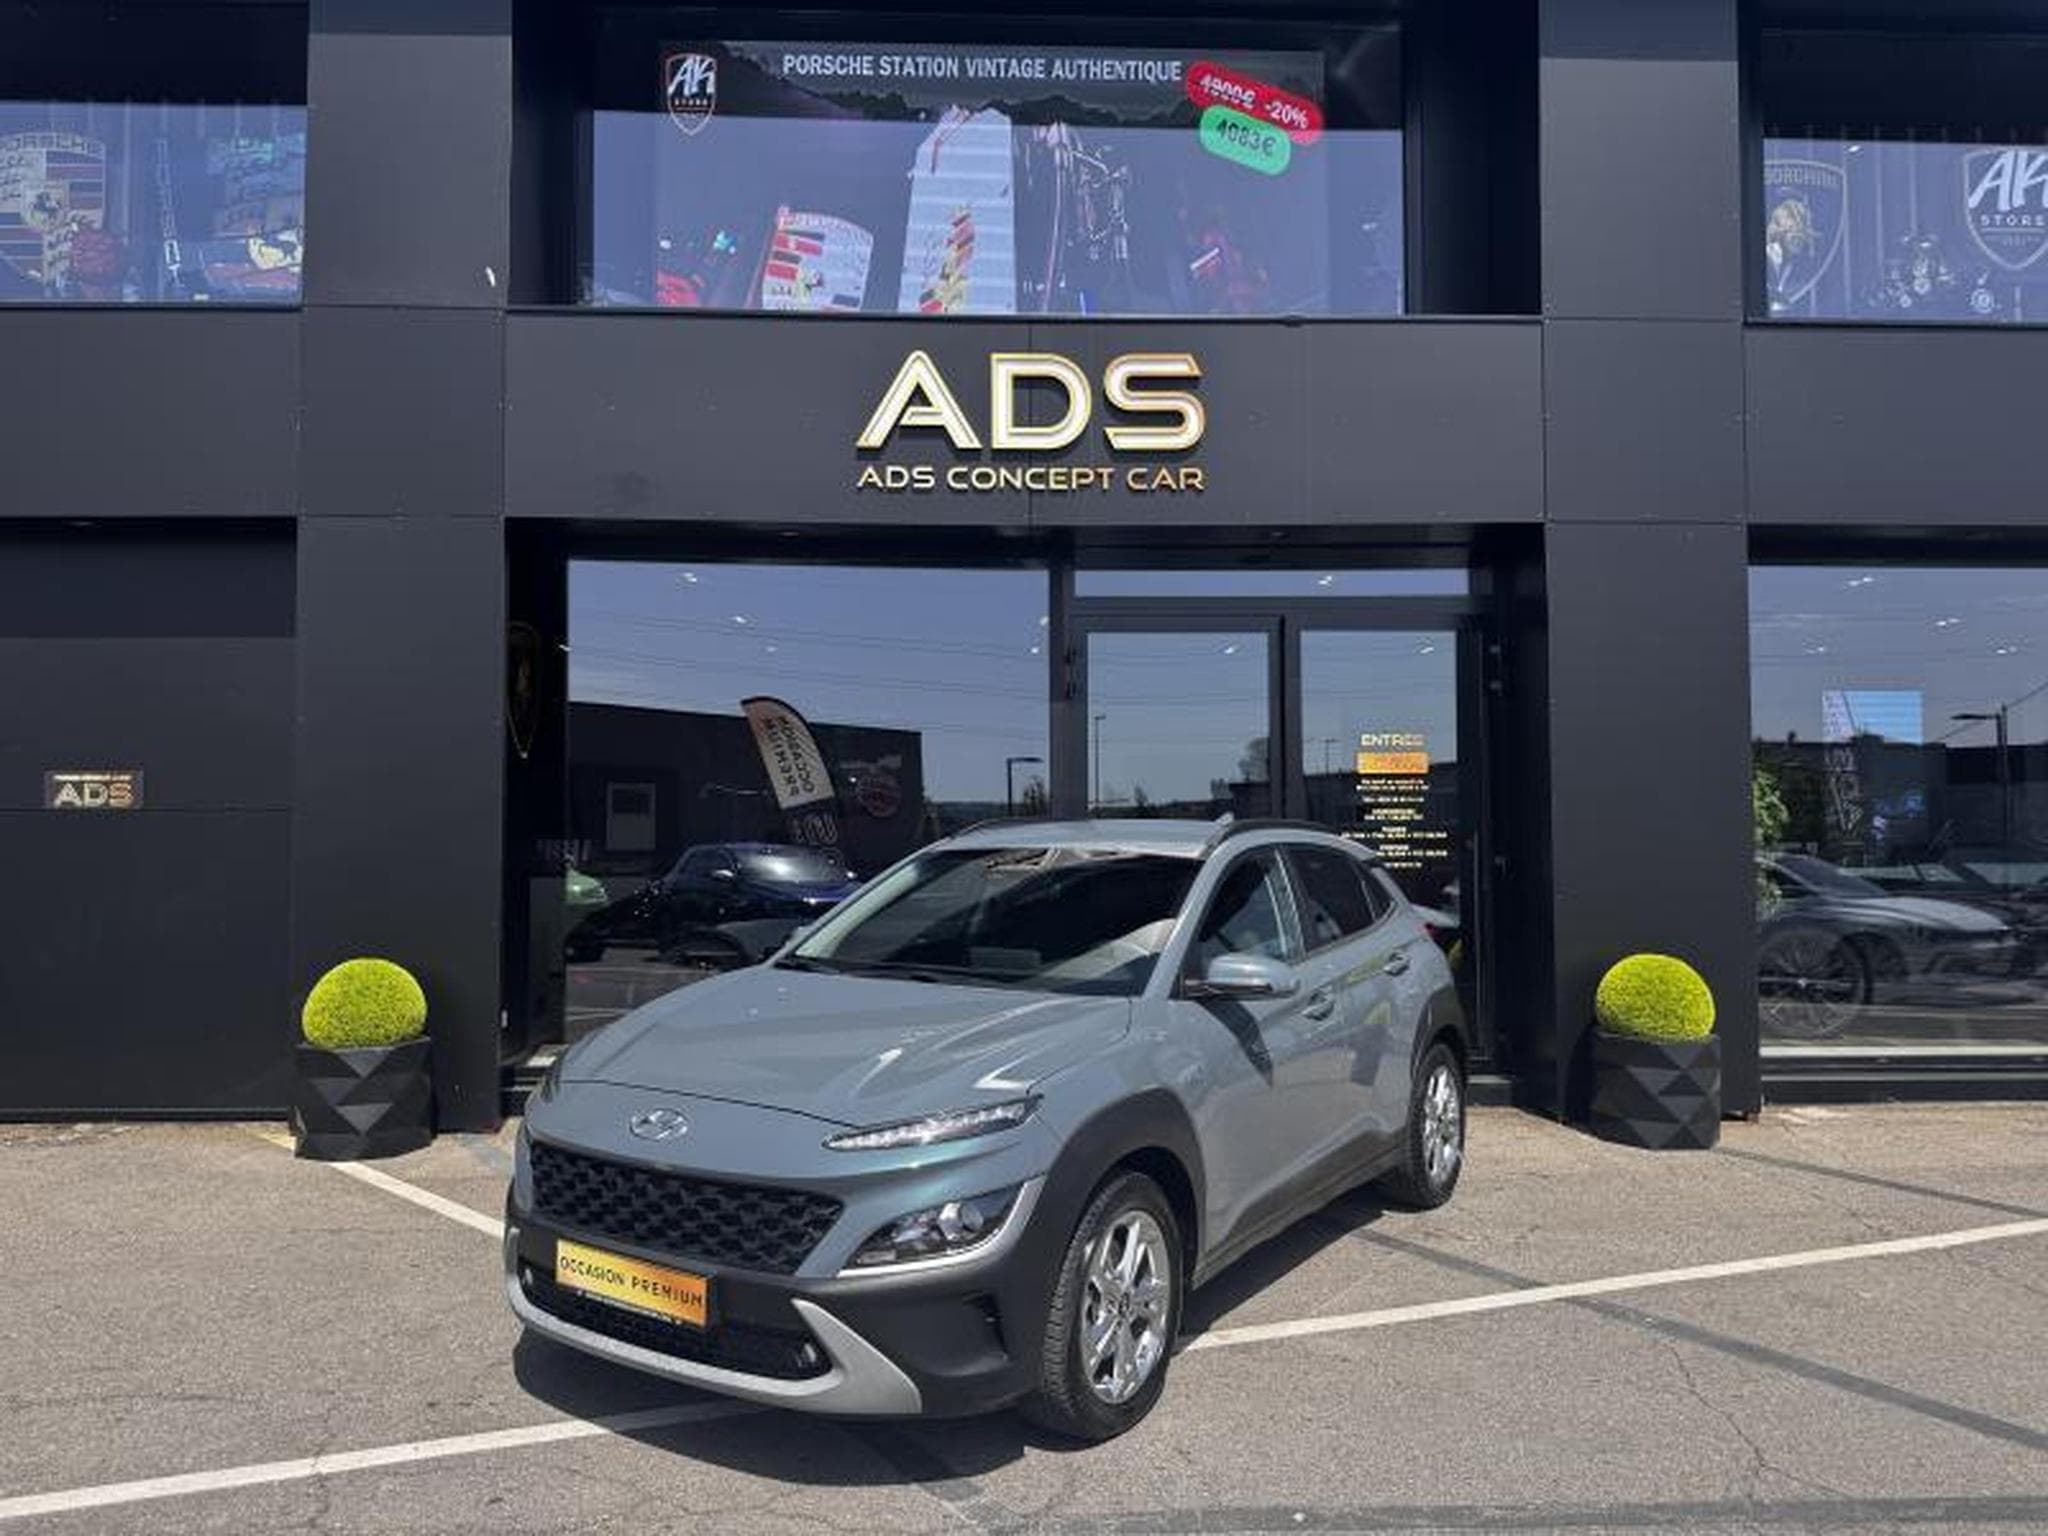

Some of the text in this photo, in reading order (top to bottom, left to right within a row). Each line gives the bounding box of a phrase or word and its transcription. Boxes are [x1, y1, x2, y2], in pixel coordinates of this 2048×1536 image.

[782, 54, 1182, 83] PORSCHE STATION VINTAGE AUTHENTIQUE
[1265, 101, 1310, 129] -20%
[1981, 214, 2046, 226] STORE
[855, 349, 1206, 451] ADS
[857, 466, 1205, 492] ADS CONCEPT CAR
[53, 782, 133, 809] ADS
[560, 1256, 702, 1305] OCCASION PREMIUM
